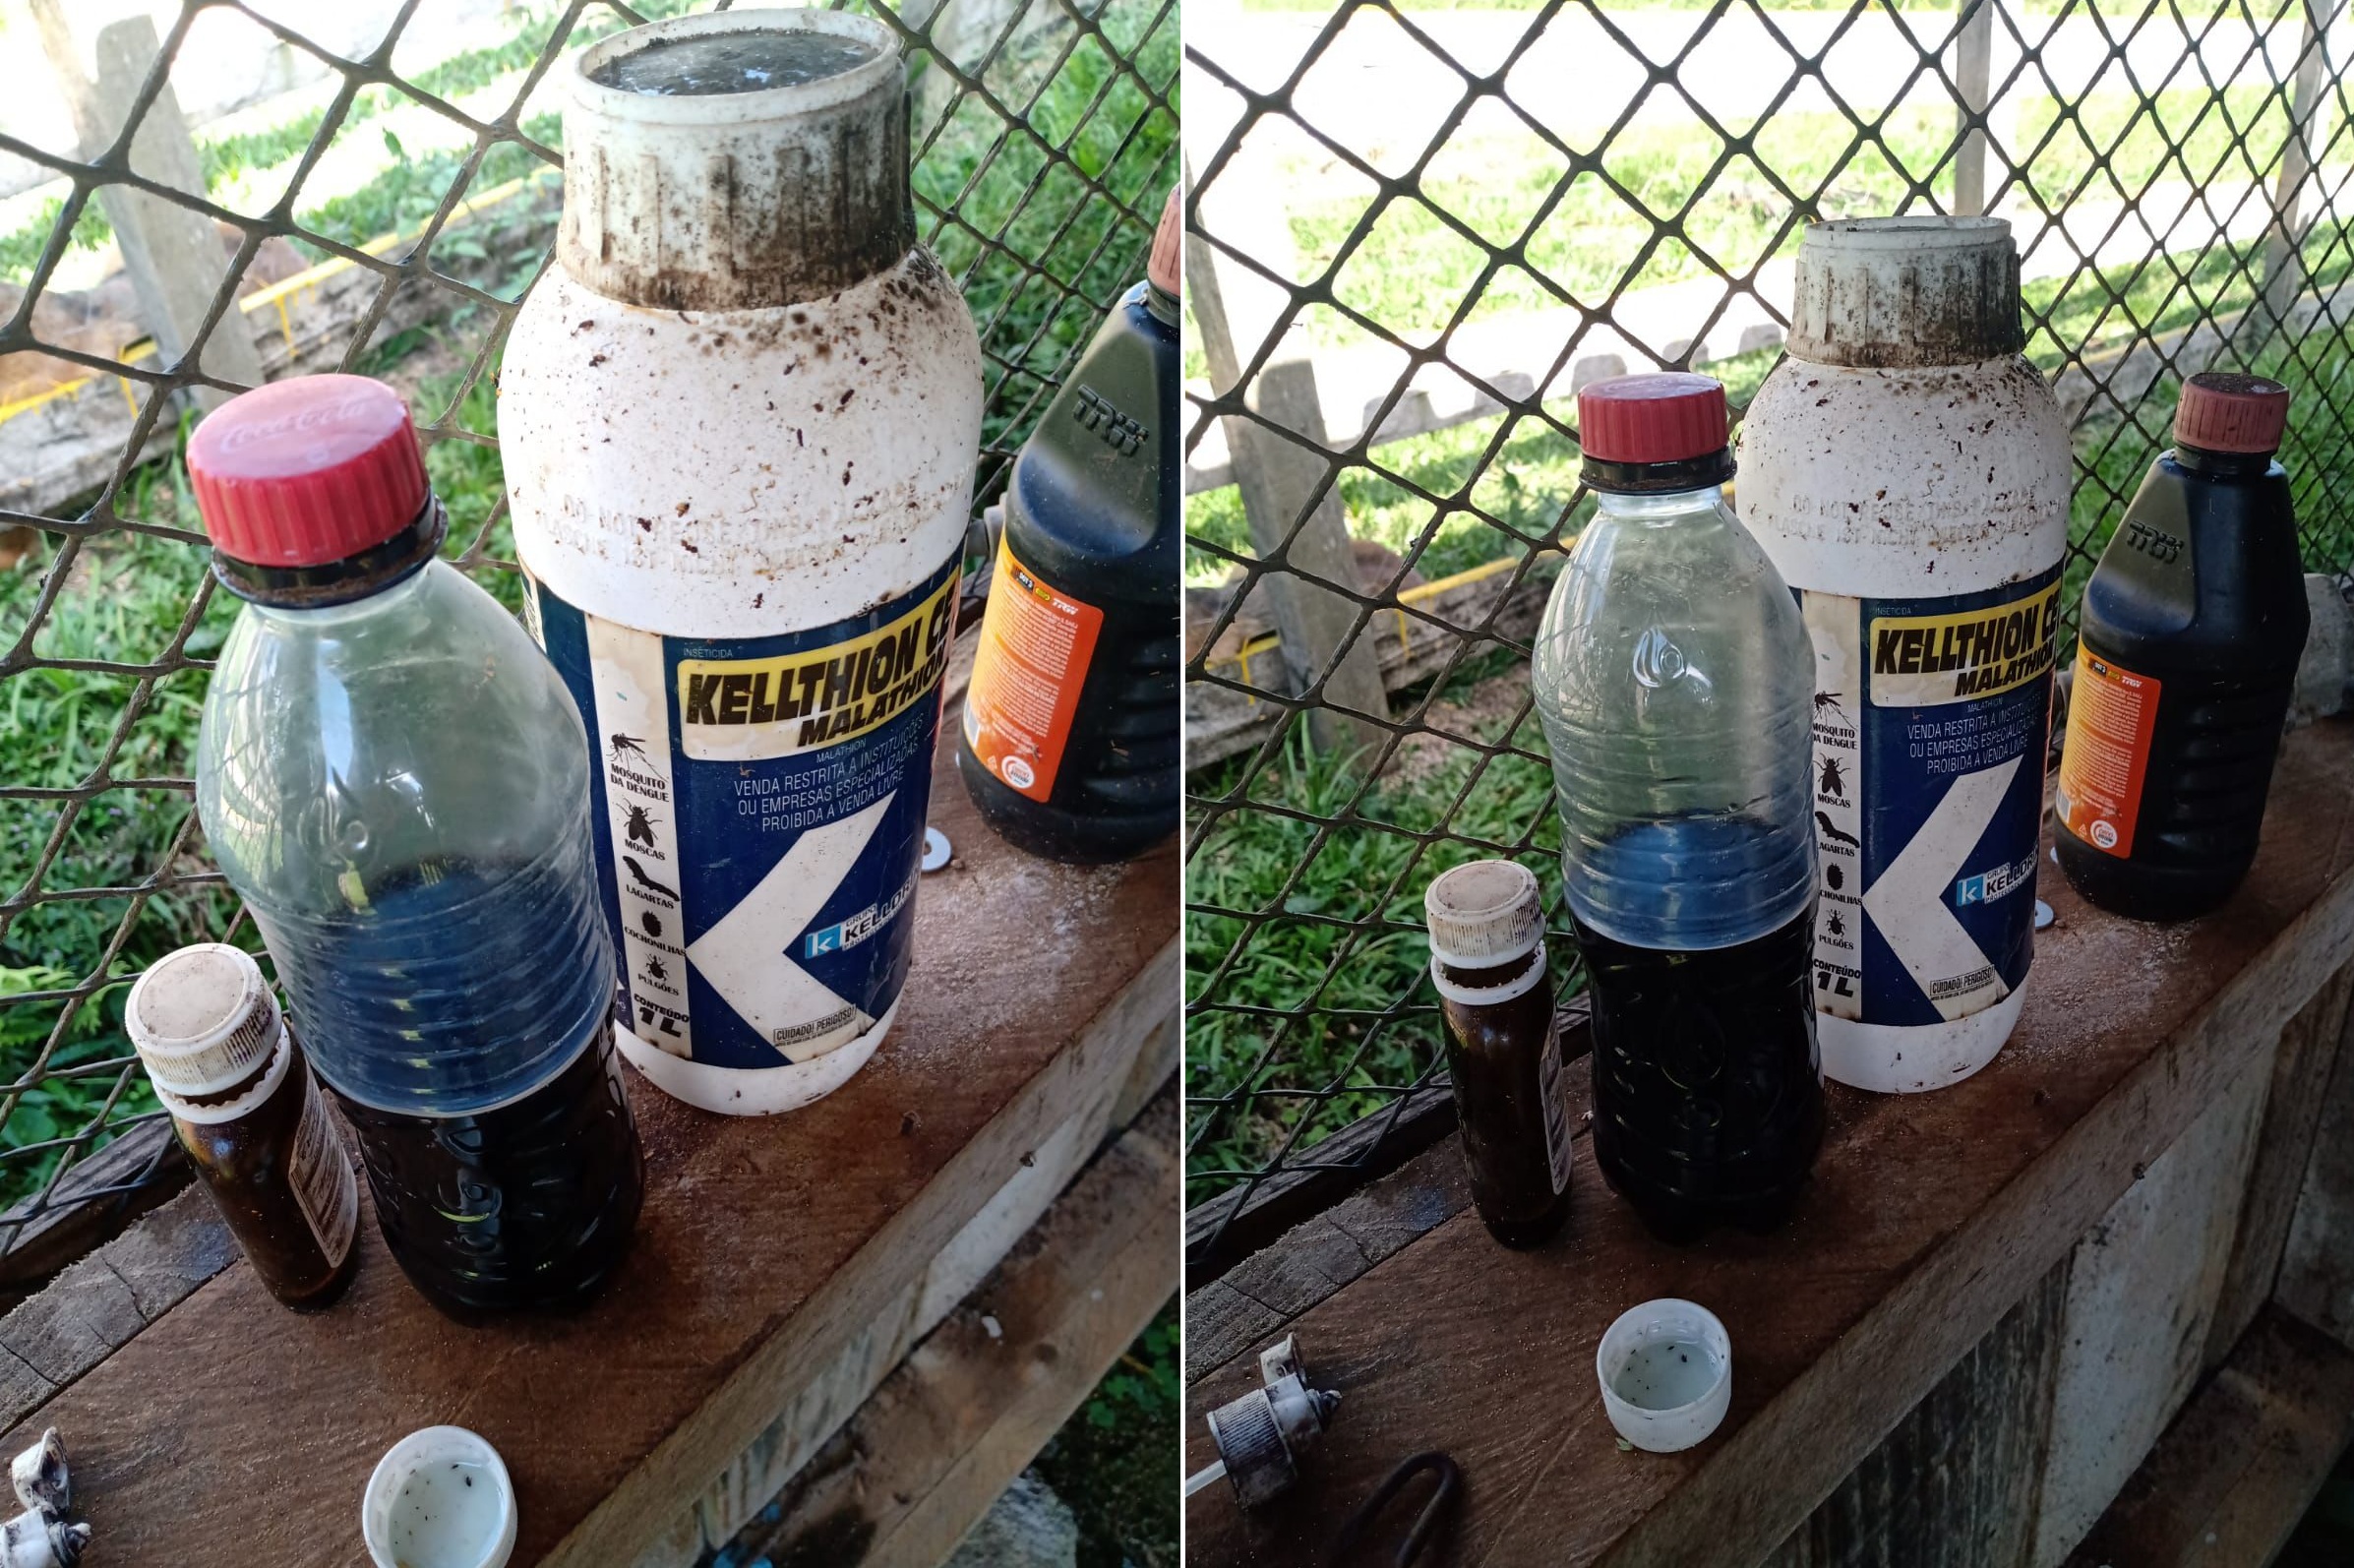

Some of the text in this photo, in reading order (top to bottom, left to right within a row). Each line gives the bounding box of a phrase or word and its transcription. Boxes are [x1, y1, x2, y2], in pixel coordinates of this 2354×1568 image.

[1875, 603, 2040, 675] KELLTHION
[683, 647, 734, 658] INSETICIDA
[686, 617, 923, 725] KELLTHION
[1954, 635, 2055, 696] MALATHION
[797, 637, 946, 747] MALATHION
[1812, 722, 1855, 738] MOSQUITO
[1907, 723, 1942, 740] VENDA
[1945, 715, 1987, 737] RESTRITA
[815, 738, 867, 763] MALATHION
[1824, 736, 1857, 750] DENGUE
[1909, 744, 1923, 757] OU
[1927, 735, 1978, 756] EMPRESAS
[1927, 754, 1972, 775] PROIBIDA
[1974, 753, 1980, 766] A
[1983, 744, 2008, 764] VENDA
[610, 763, 666, 791] MOSQUITO
[610, 773, 670, 802] DA DENGUE
[734, 777, 780, 796] VENDA
[784, 762, 845, 792] RESTRITA
[848, 756, 858, 774] A
[738, 737, 919, 815] OU EMPRESAS ESPECIALIZADAS
[762, 765, 904, 832] PROIBIDA A VENDA LIVRE
[1818, 793, 1850, 808] MOSCAS
[625, 838, 666, 861] MOSCAS
[1818, 842, 1855, 857] AGARTAS
[626, 883, 675, 909] LAGARTAS
[846, 904, 876, 928] GRUPO
[624, 926, 687, 957] COCHONILHAS
[1818, 934, 1854, 950] PULGÕES
[1813, 958, 1861, 979] CONTEÚDO
[637, 973, 680, 996] PULGÕES
[1932, 976, 1962, 994] CUIDADO!
[634, 993, 690, 1023] CONTEÚDO
[776, 1023, 814, 1041] CUIDADO!
